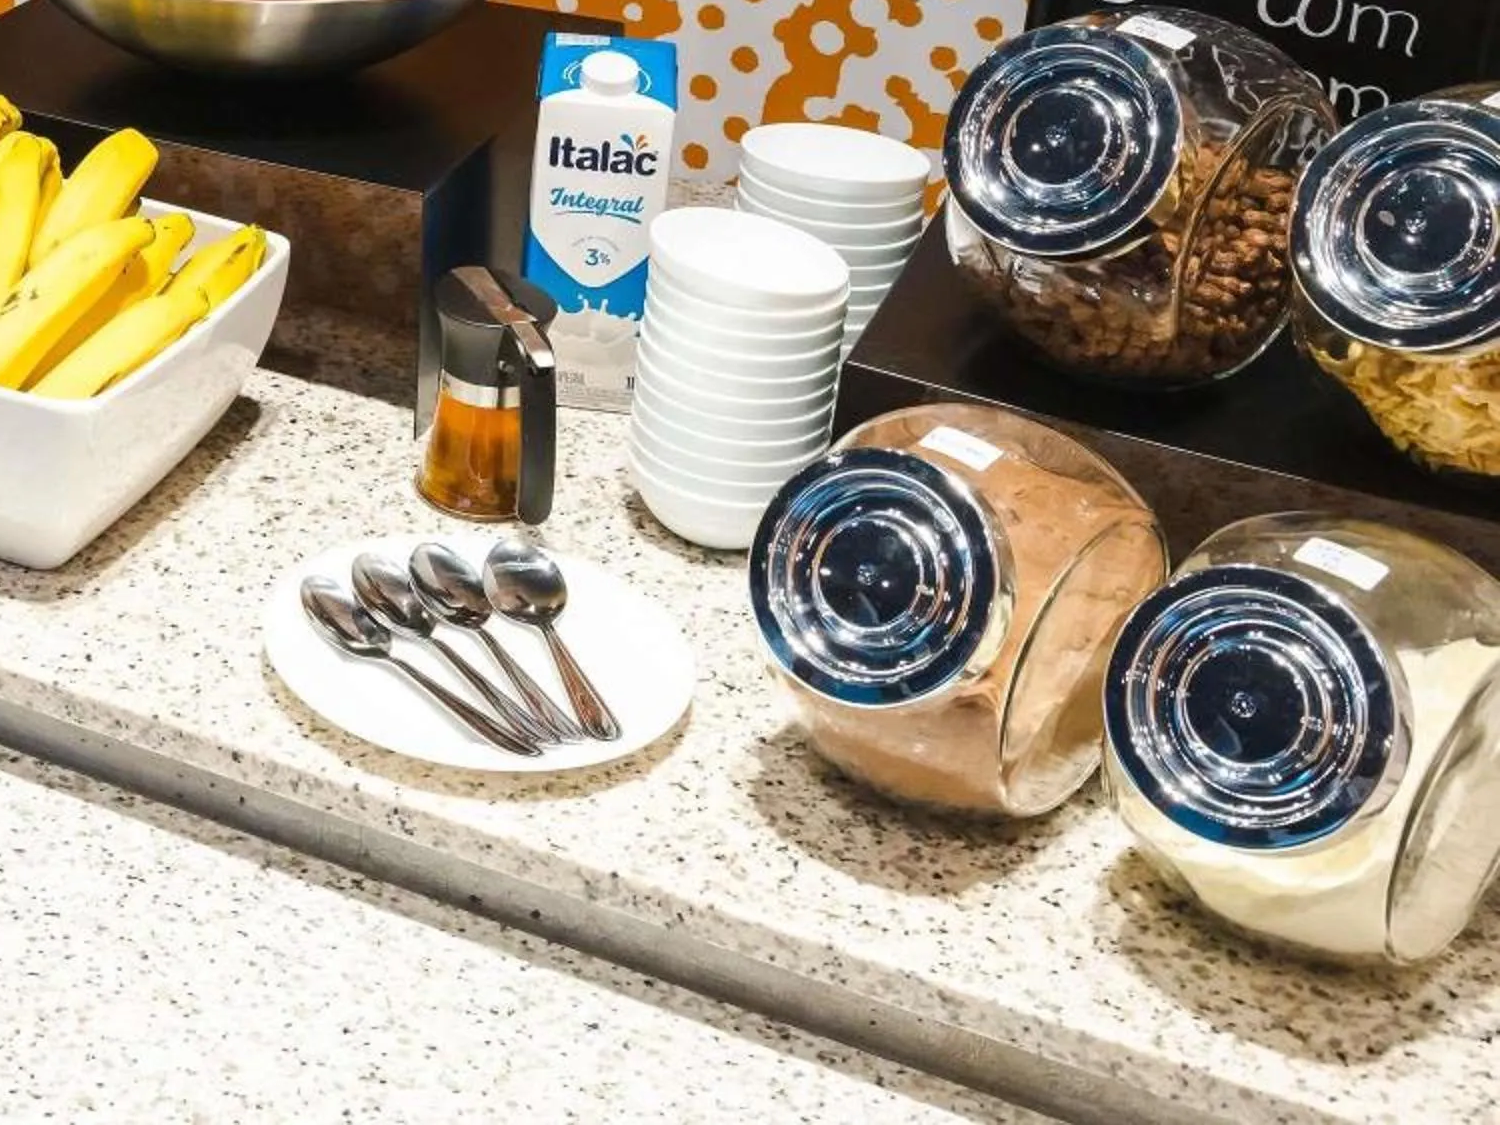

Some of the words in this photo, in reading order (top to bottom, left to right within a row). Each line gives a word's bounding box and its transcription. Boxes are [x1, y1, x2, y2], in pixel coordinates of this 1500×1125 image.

[549, 135, 657, 176] Italac
[550, 187, 644, 216] Integral
[585, 248, 611, 266] 3%
